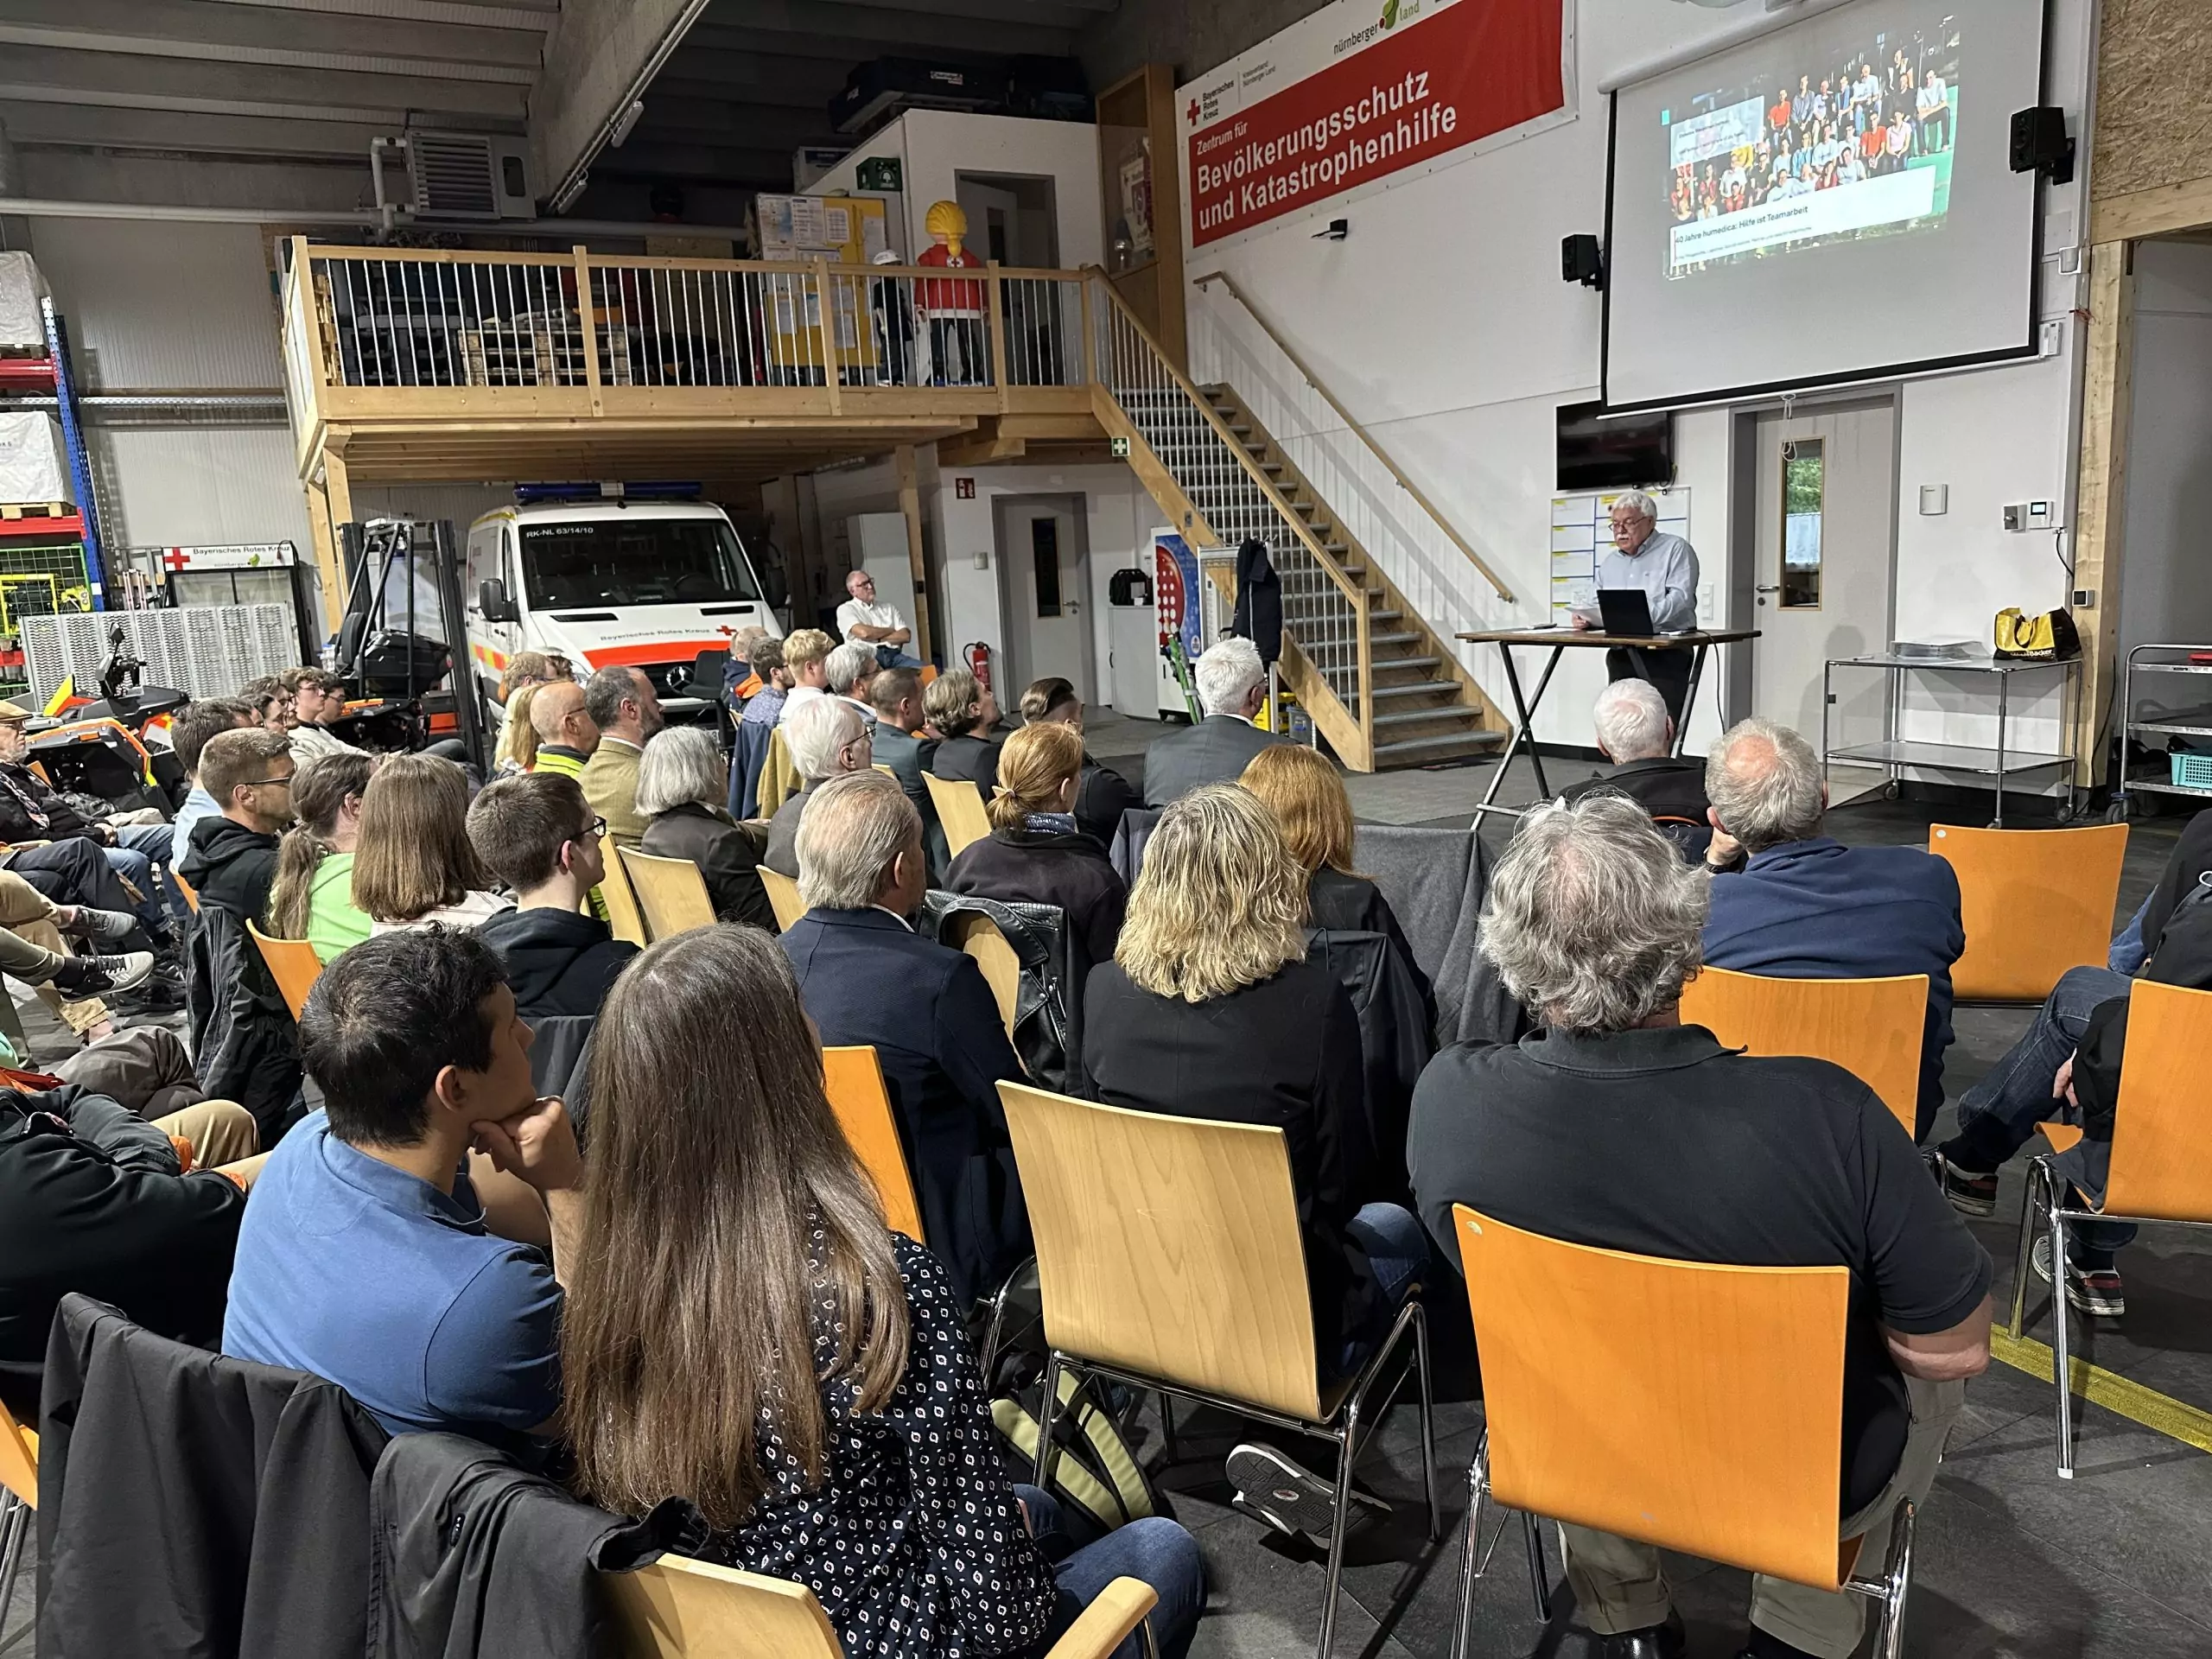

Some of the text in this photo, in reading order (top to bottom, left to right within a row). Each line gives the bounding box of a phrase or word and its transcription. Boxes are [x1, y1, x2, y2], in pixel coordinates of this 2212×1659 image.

[1333, 3, 1420, 55] nürnberger land
[1202, 80, 1234, 101] Bayerisches
[1203, 99, 1218, 111] Rotes
[1203, 109, 1219, 122] Kreuz
[1197, 121, 1249, 156] Zentrum für
[1198, 71, 1429, 194] Bevölkerungsschutz
[1199, 103, 1457, 230] und Katastrophenhilfe
[1675, 235, 1684, 244] 40
[1684, 232, 1702, 243] Jahre
[1702, 223, 1738, 238] humedica:
[1738, 217, 1756, 229] Hilfe
[1767, 206, 1808, 222] Teamarbeit
[525, 529, 555, 538] RK-NL
[193, 547, 242, 556] Bayerisches
[601, 632, 655, 641] Bayerisches
